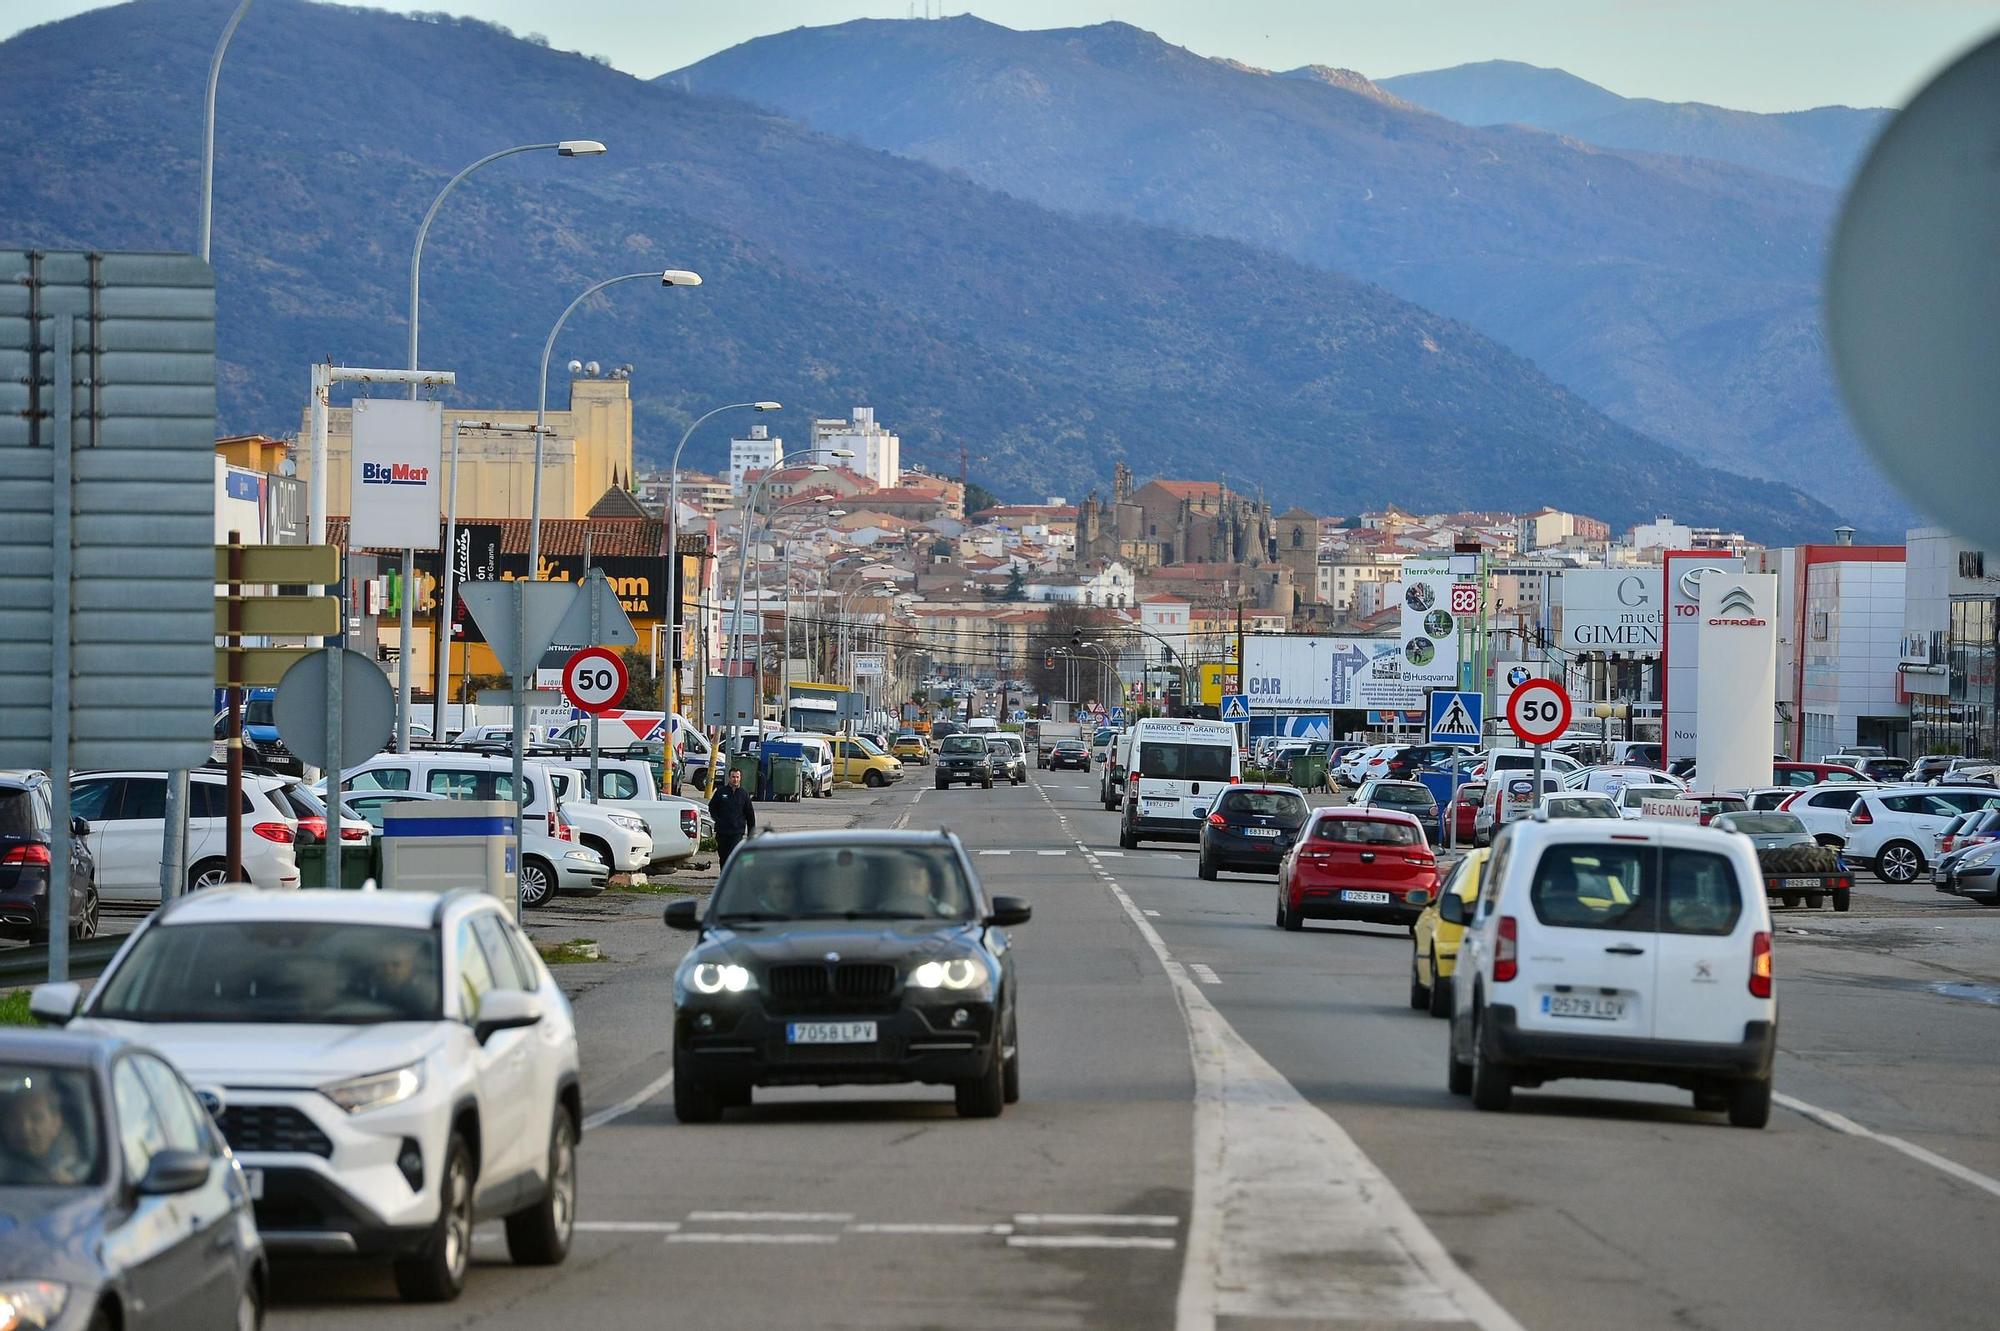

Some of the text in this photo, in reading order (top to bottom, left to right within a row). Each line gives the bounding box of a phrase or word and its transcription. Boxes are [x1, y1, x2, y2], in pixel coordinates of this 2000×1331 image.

[363, 463, 428, 484] BigMat
[1620, 610, 1664, 623] mueb
[1574, 625, 1663, 644] GIMEN
[578, 670, 613, 691] 50
[1412, 674, 1454, 682] Husqvarna
[1249, 677, 1281, 695] CAR
[1249, 696, 1265, 704] entro
[1523, 701, 1558, 722] 50
[1144, 724, 1186, 732] MARMOLES
[1674, 730, 1698, 739] Nov
[1642, 803, 1699, 817] MECANICA
[797, 1024, 838, 1041] 7058
